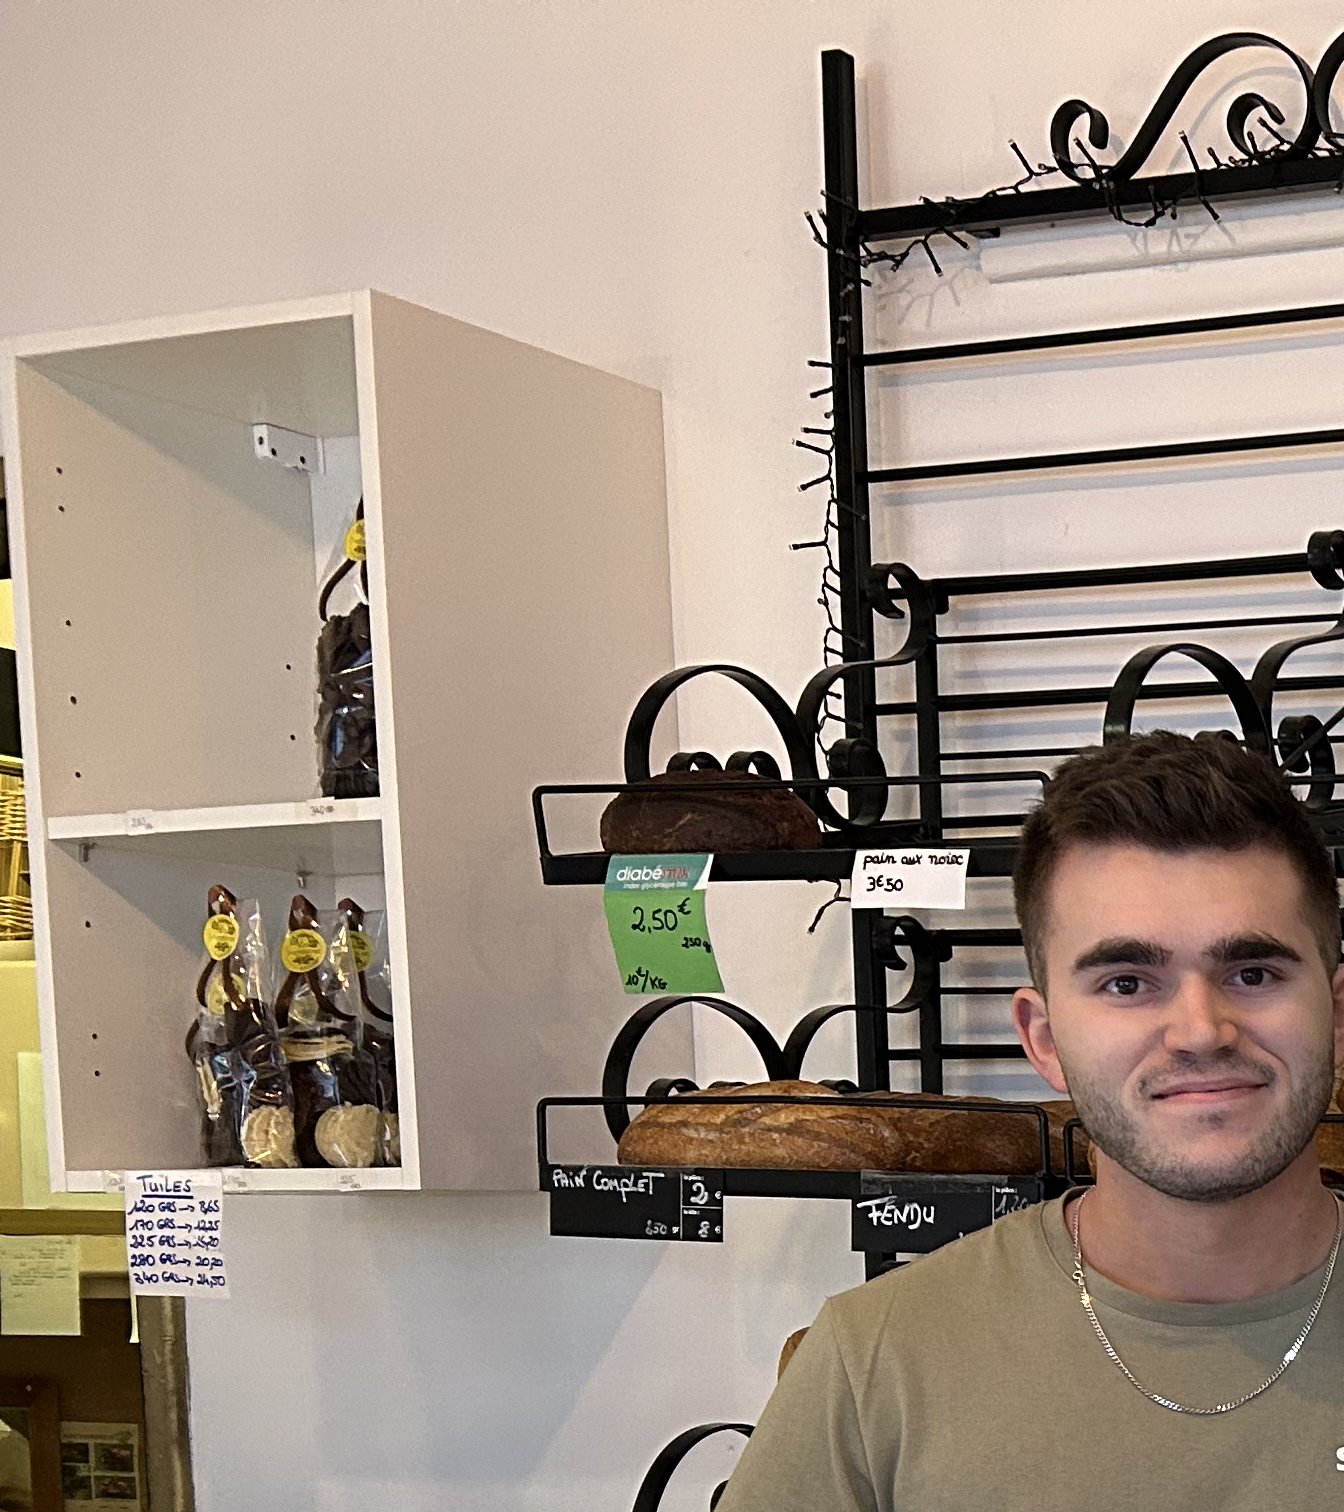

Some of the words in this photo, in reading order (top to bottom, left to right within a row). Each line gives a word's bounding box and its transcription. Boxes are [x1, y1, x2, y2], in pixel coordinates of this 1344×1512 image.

[863, 852, 897, 870] pain
[901, 854, 922, 865] aux
[690, 1182, 708, 1204] 2
[127, 1200, 155, 1215] 120
[856, 1194, 935, 1230] FENDU
[129, 1219, 154, 1231] 170
[130, 1235, 157, 1248] 225
[130, 1254, 155, 1267] 280
[133, 1271, 159, 1284] 340
